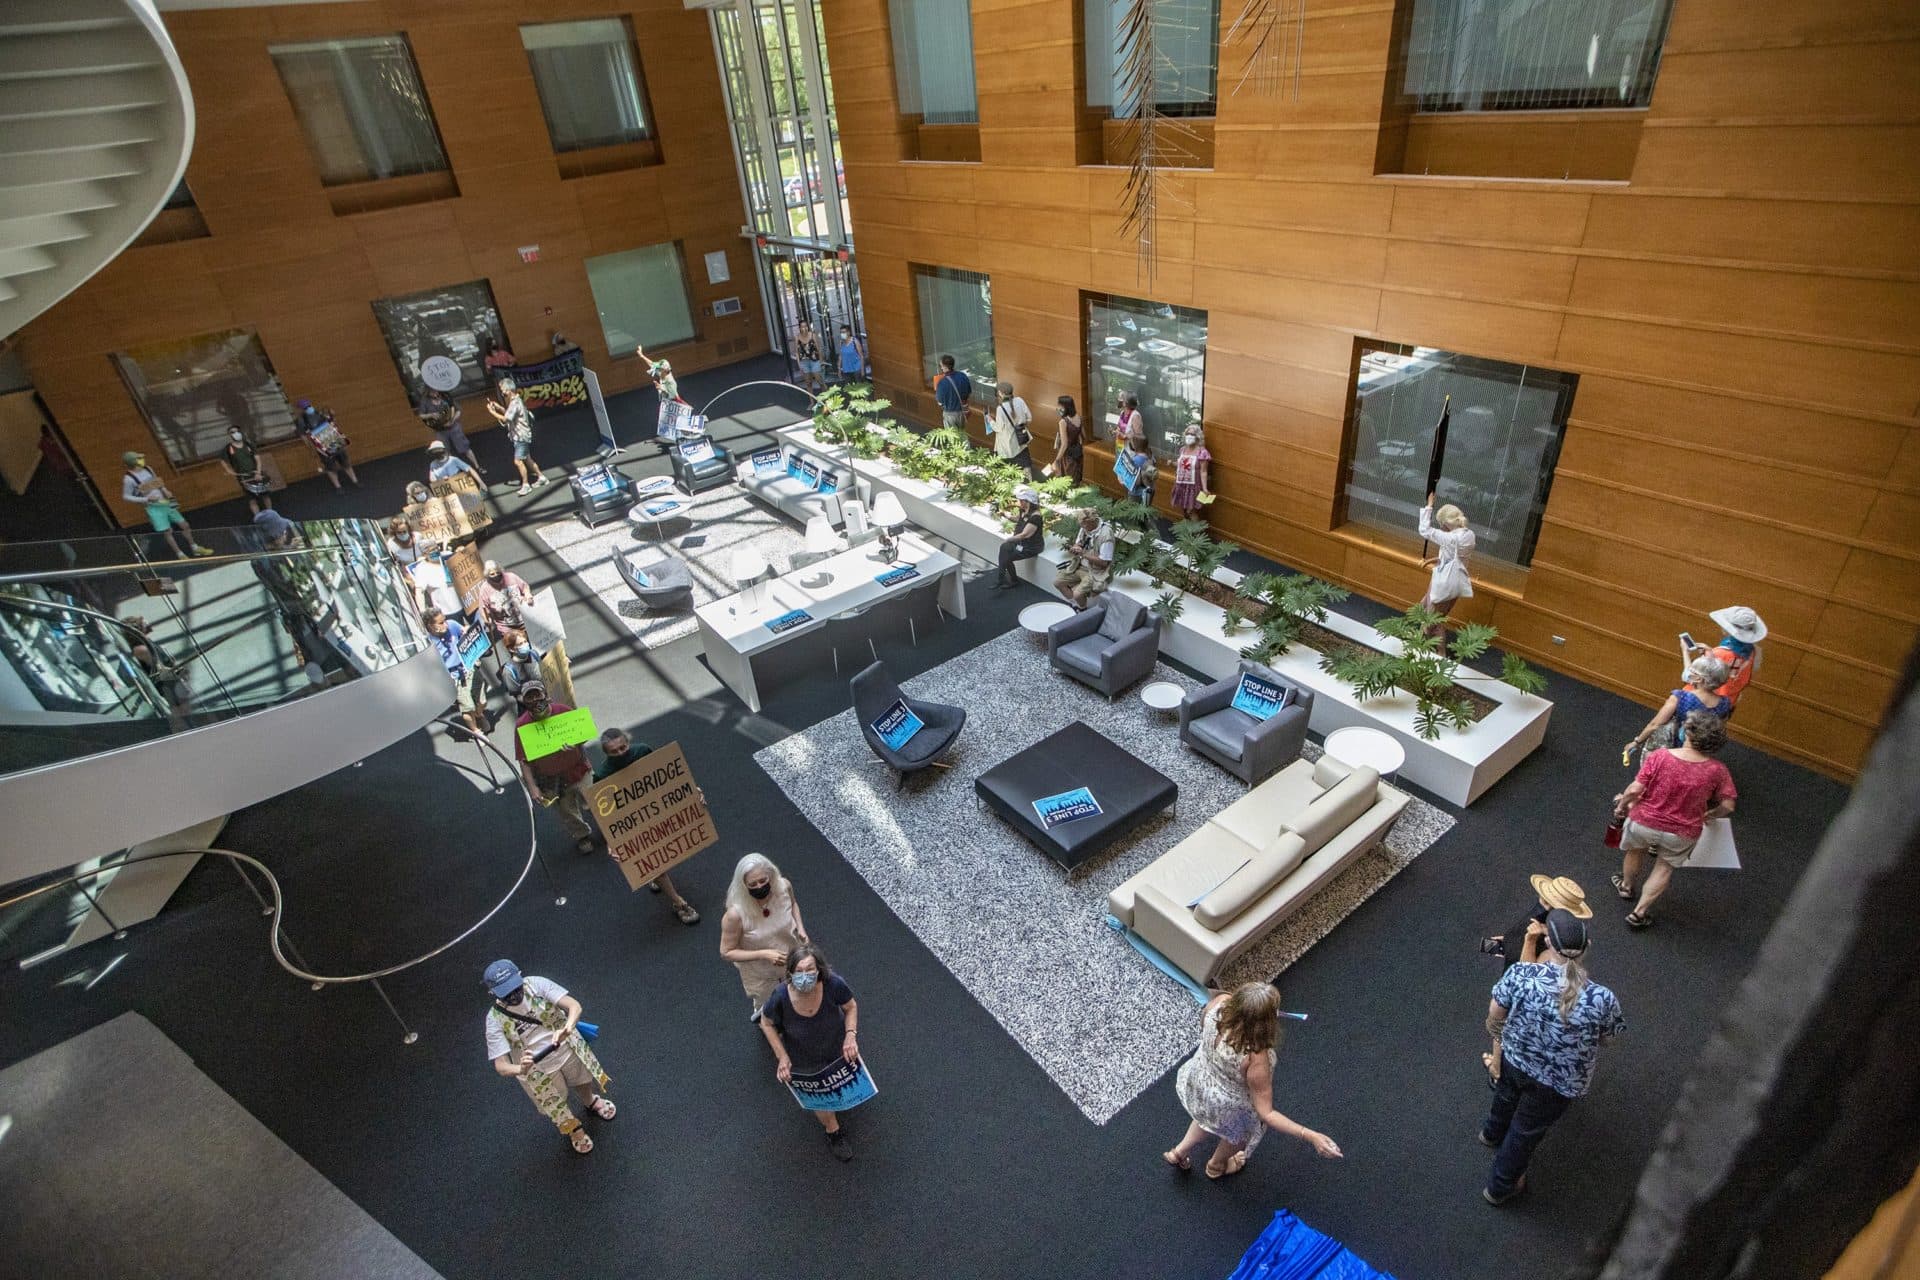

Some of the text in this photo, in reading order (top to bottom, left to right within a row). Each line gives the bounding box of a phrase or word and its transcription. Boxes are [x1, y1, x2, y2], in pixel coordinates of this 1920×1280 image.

[455, 475, 475, 490] THE
[463, 570, 477, 587] THE
[1243, 680, 1261, 691] STOP
[1261, 686, 1277, 698] LINE
[1277, 692, 1283, 701] 3
[878, 718, 891, 732] STOP
[890, 708, 902, 721] LINE
[613, 757, 685, 809] ENBRIDGE
[609, 782, 693, 839] PROFITS FROM
[1053, 811, 1073, 821] LINE
[1074, 804, 1095, 816] STOP
[615, 803, 705, 863] ENVIRONMENTAL
[634, 822, 710, 878] INJUSTICE
[791, 1061, 858, 1089] STOP LINE 3
